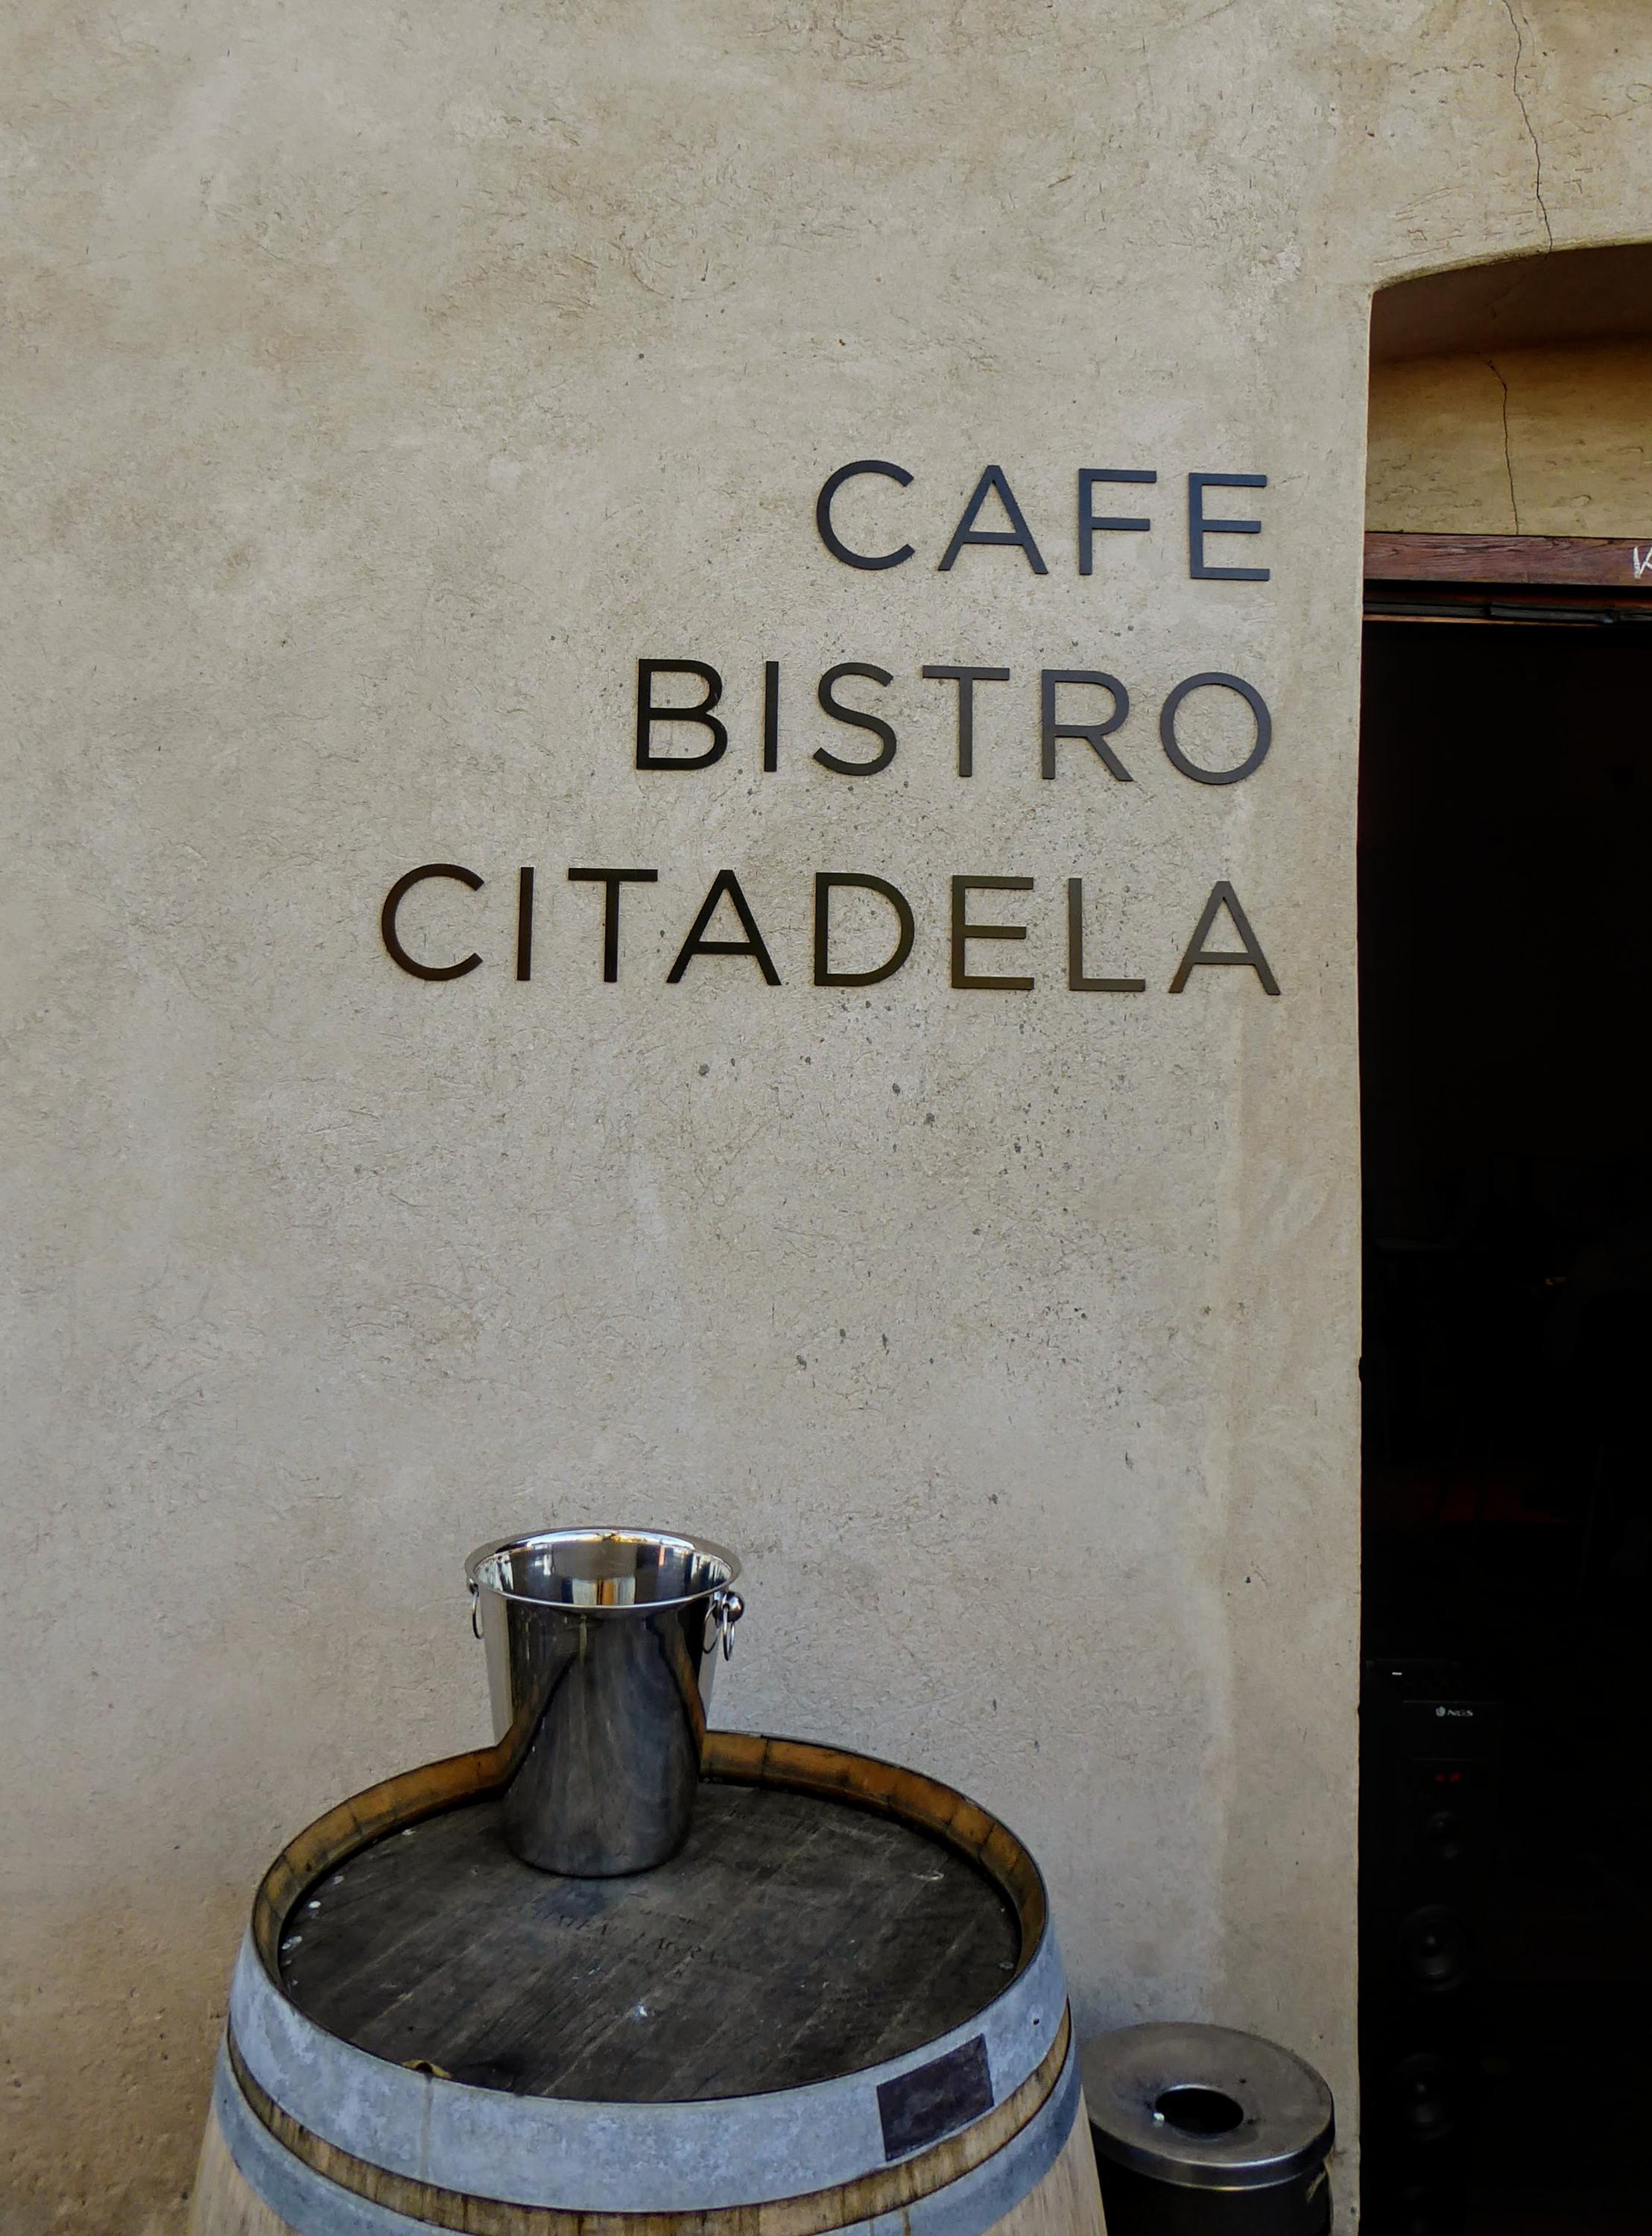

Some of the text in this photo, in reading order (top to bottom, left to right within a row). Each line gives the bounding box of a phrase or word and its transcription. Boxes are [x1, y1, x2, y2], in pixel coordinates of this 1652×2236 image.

[816, 459, 1271, 582] CAFE
[636, 658, 1272, 786] BISTRO
[382, 863, 1282, 997] CITADELA
